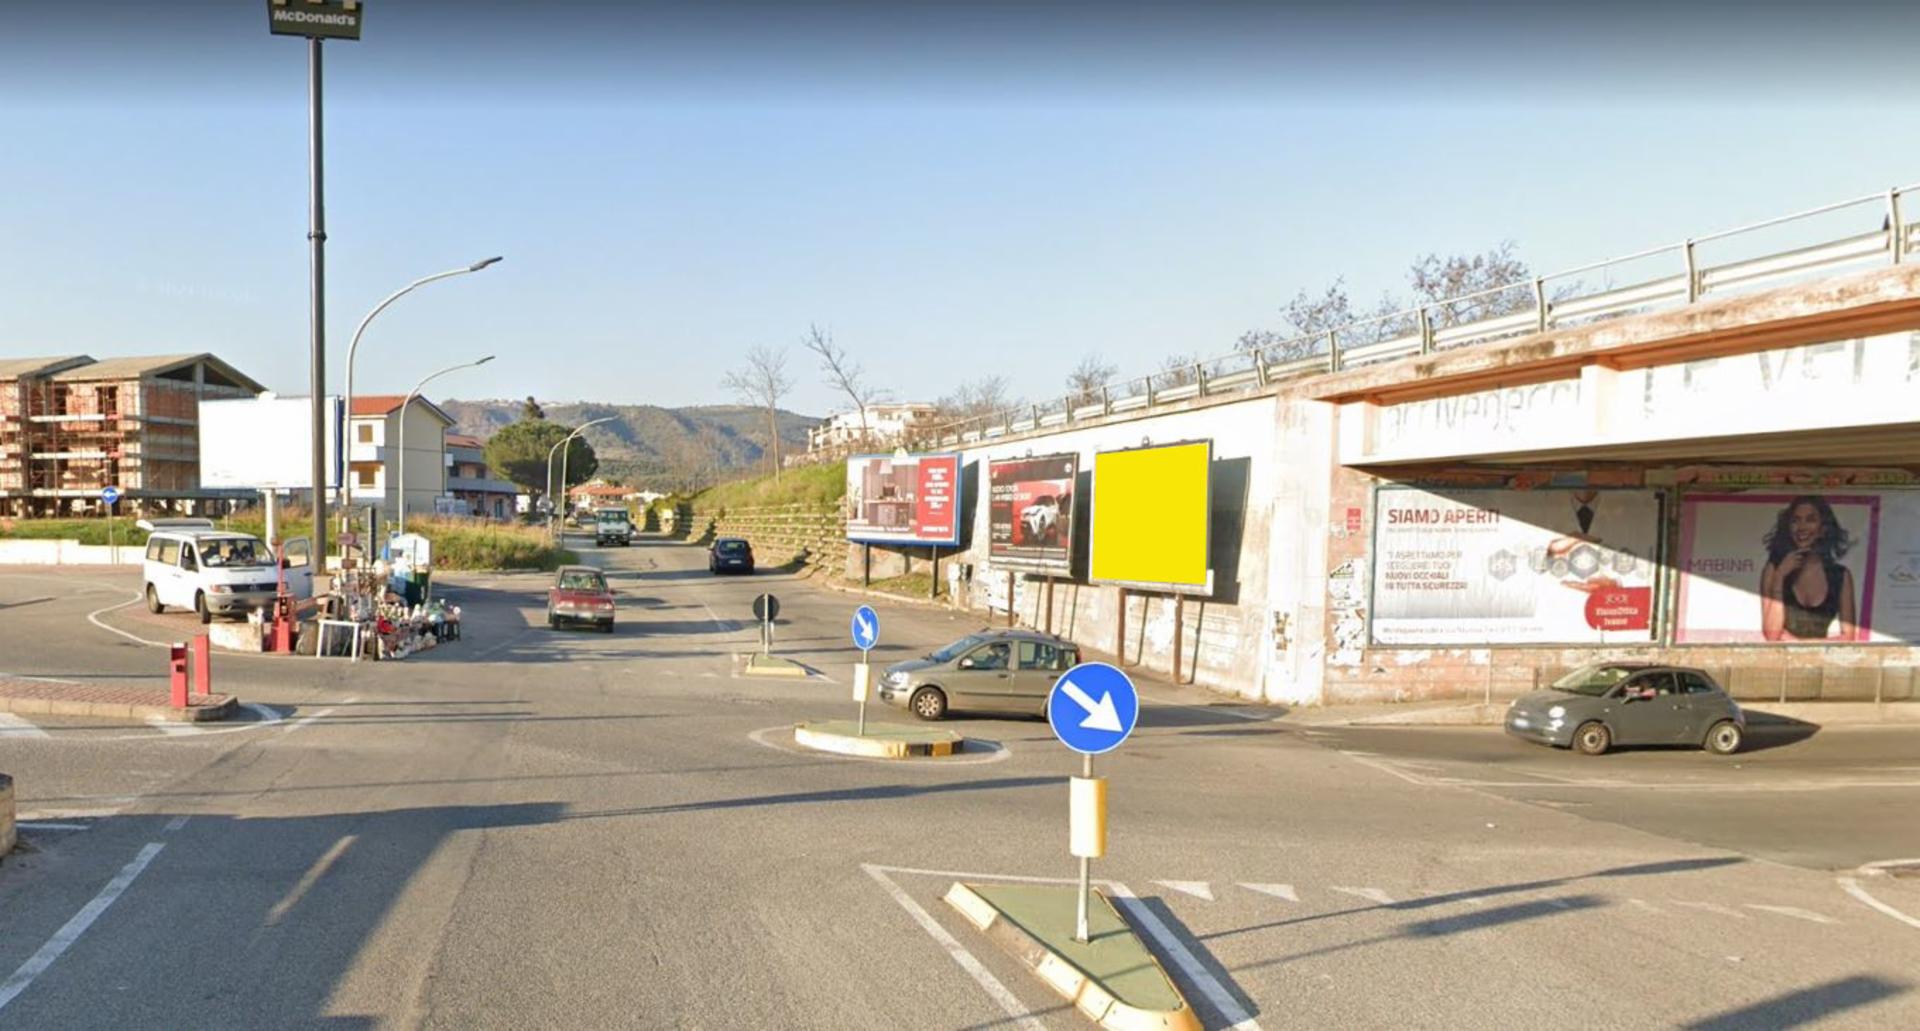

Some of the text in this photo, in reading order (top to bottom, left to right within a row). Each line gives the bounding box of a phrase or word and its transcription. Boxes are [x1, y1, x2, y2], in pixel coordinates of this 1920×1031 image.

[274, 10, 356, 26] McDonald's
[1387, 508, 1500, 524] SIAMO APERTI
[1686, 558, 1754, 572] MABINA
